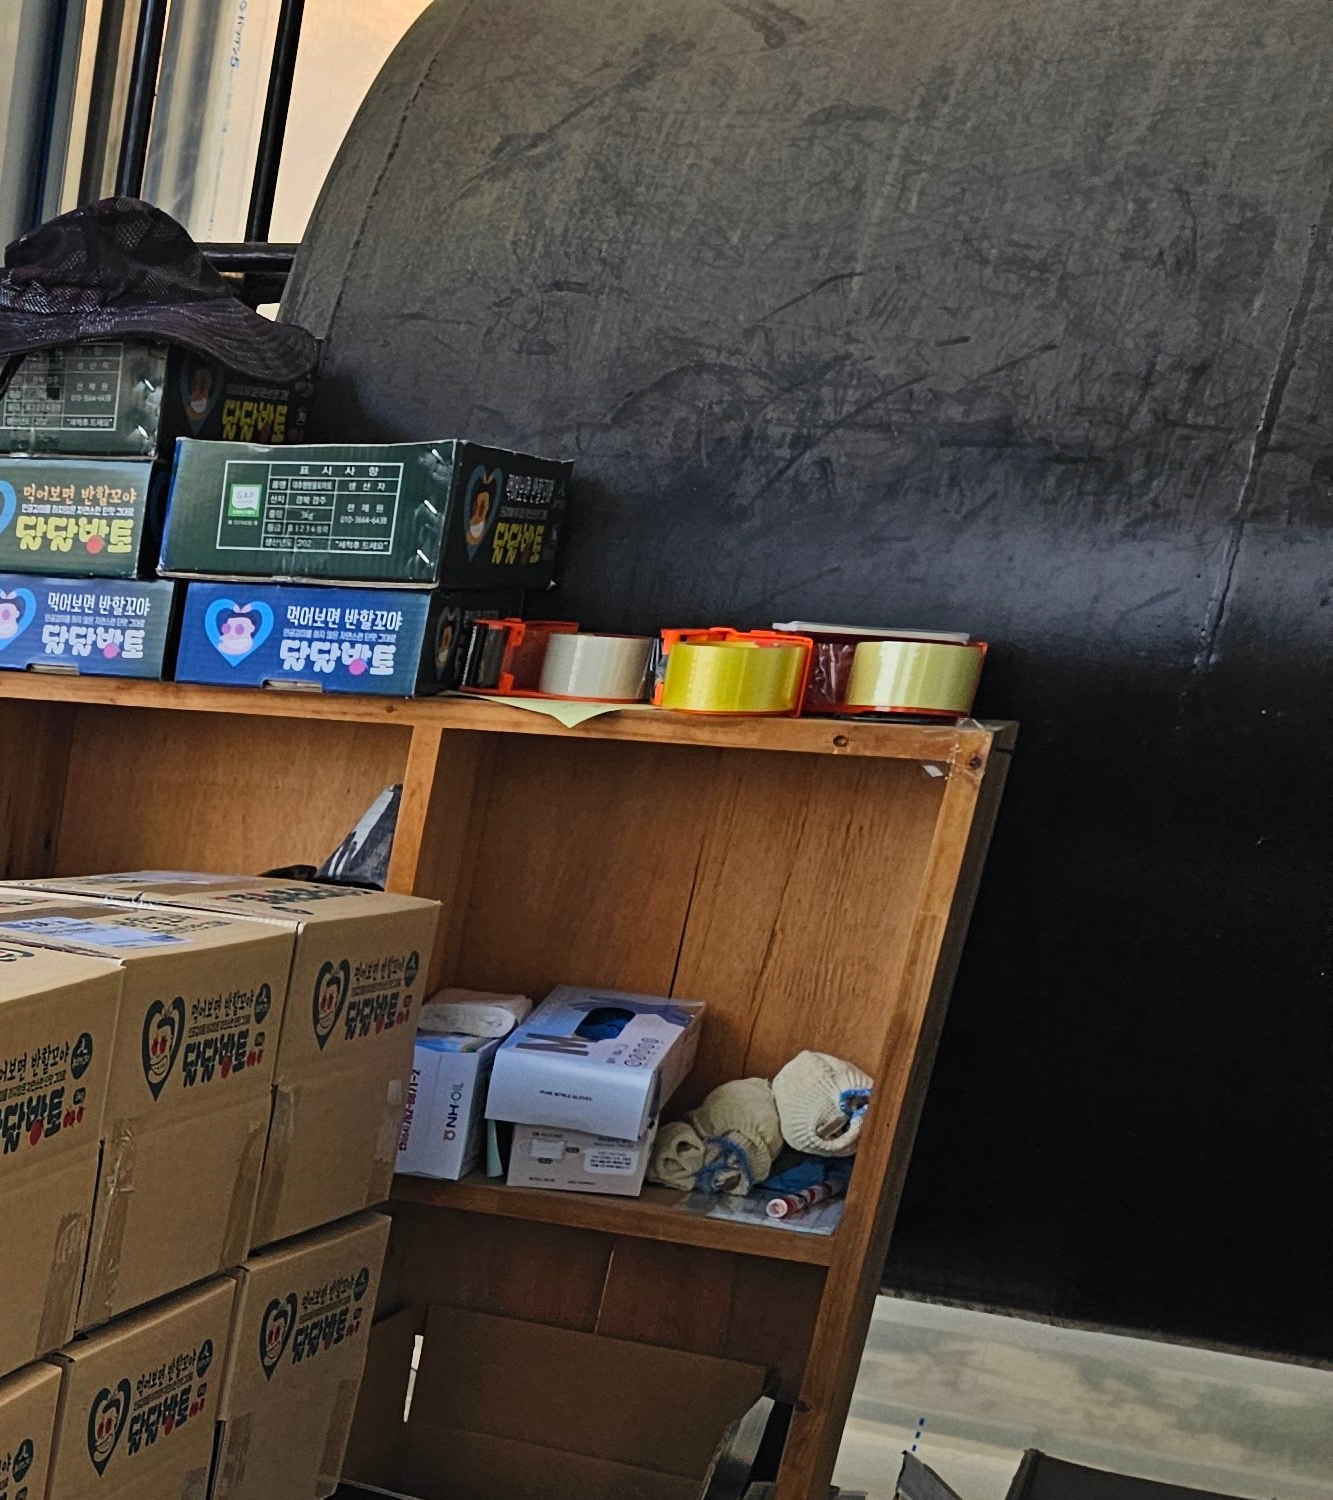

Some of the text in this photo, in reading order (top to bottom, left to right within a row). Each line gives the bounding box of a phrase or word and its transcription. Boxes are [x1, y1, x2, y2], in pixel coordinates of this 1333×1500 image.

[22, 483, 138, 504] 먹어보면 반할꼬야
[15, 515, 134, 554] 달달방토
[47, 592, 150, 615] 먹어보면 반할꼬야
[287, 606, 402, 632] 먹어보면 반할꼬야
[280, 640, 396, 676] 달달방토
[31, 1041, 70, 1077] 반할꼬야
